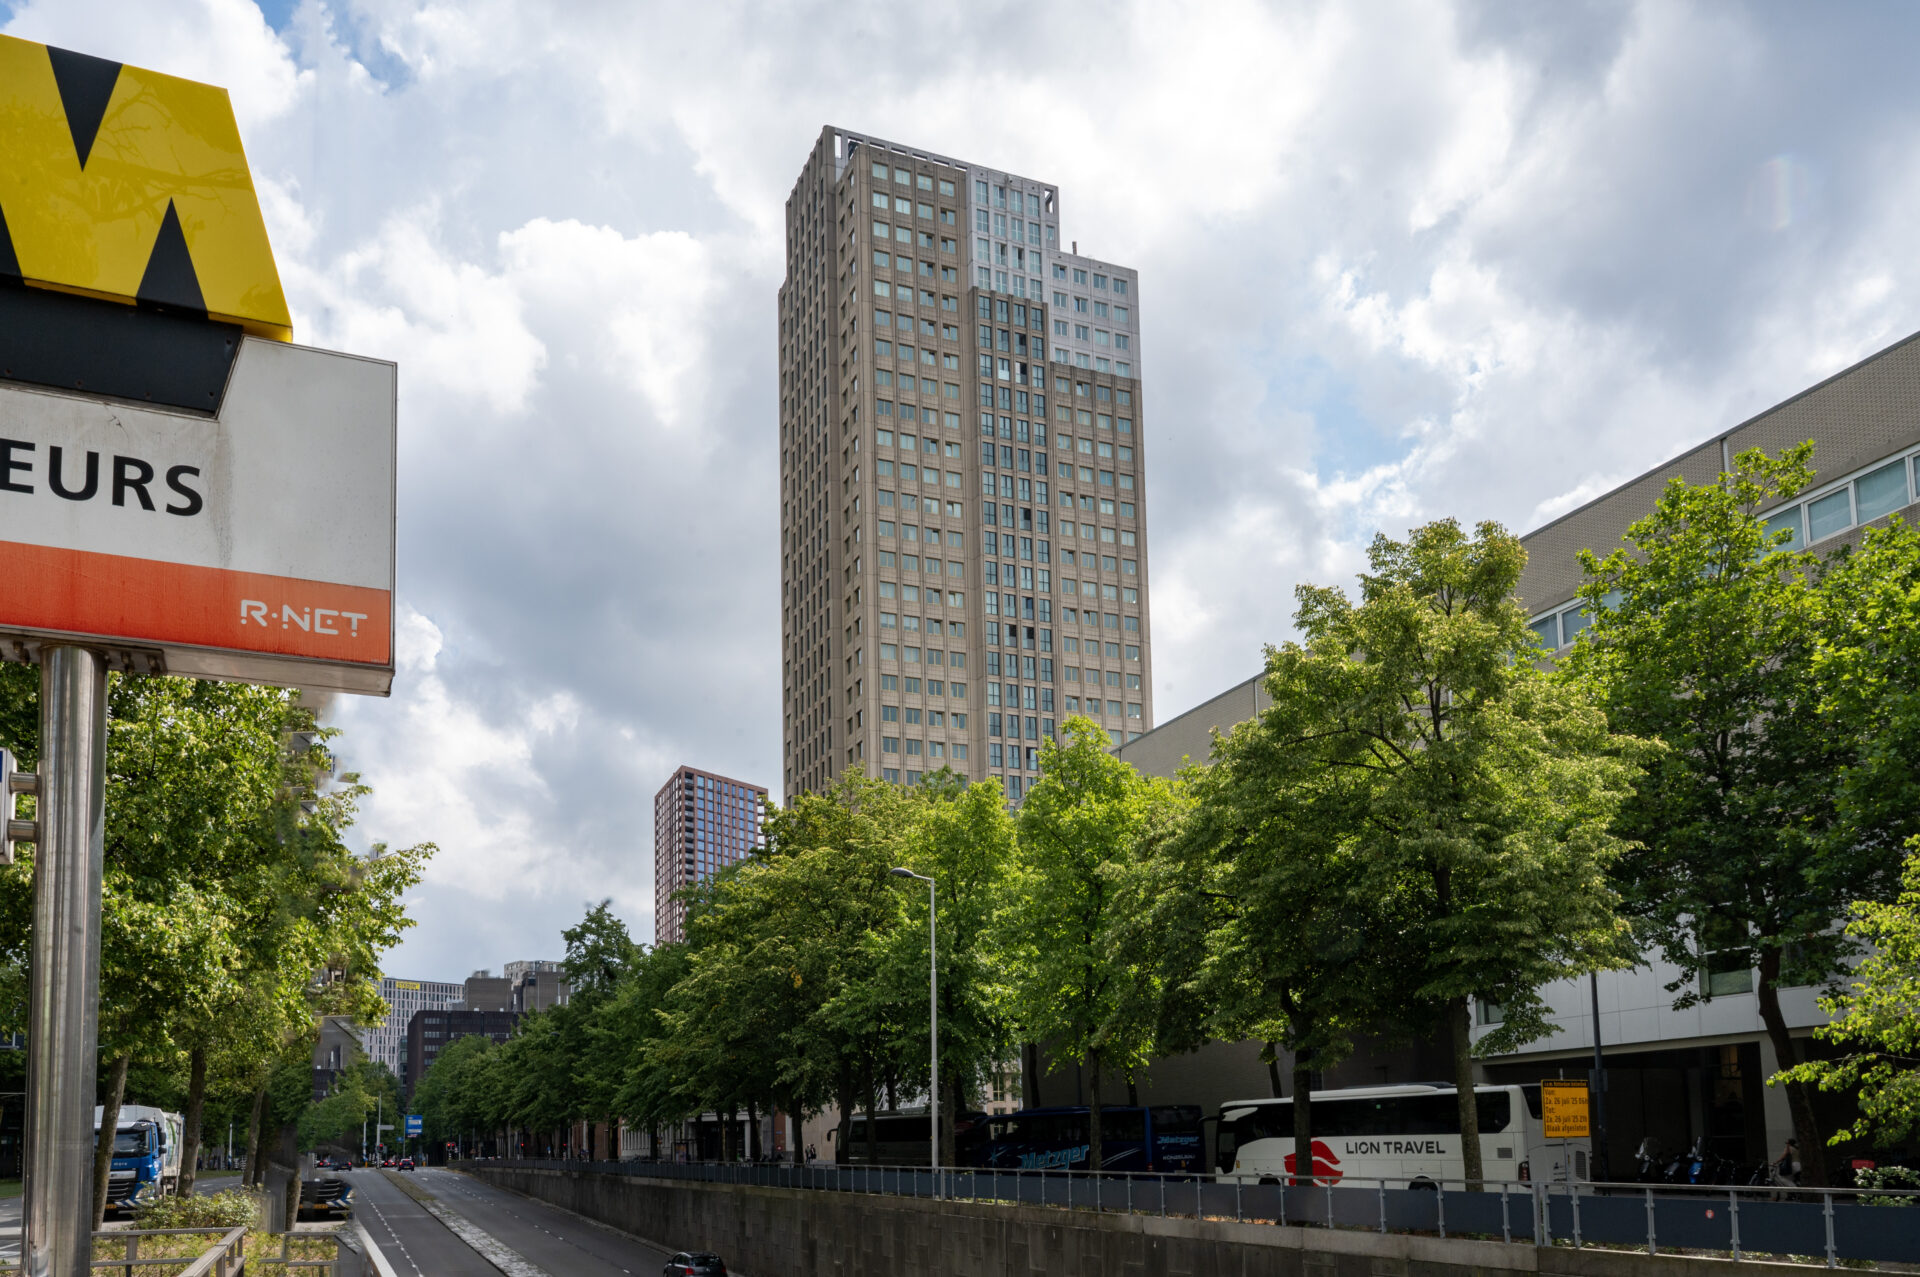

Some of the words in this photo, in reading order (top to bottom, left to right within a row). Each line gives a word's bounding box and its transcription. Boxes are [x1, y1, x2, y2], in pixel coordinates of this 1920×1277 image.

[1019, 1144, 1090, 1170] Metzger
[1346, 1141, 1380, 1155] LION
[1383, 1141, 1446, 1154] TRAVEL
